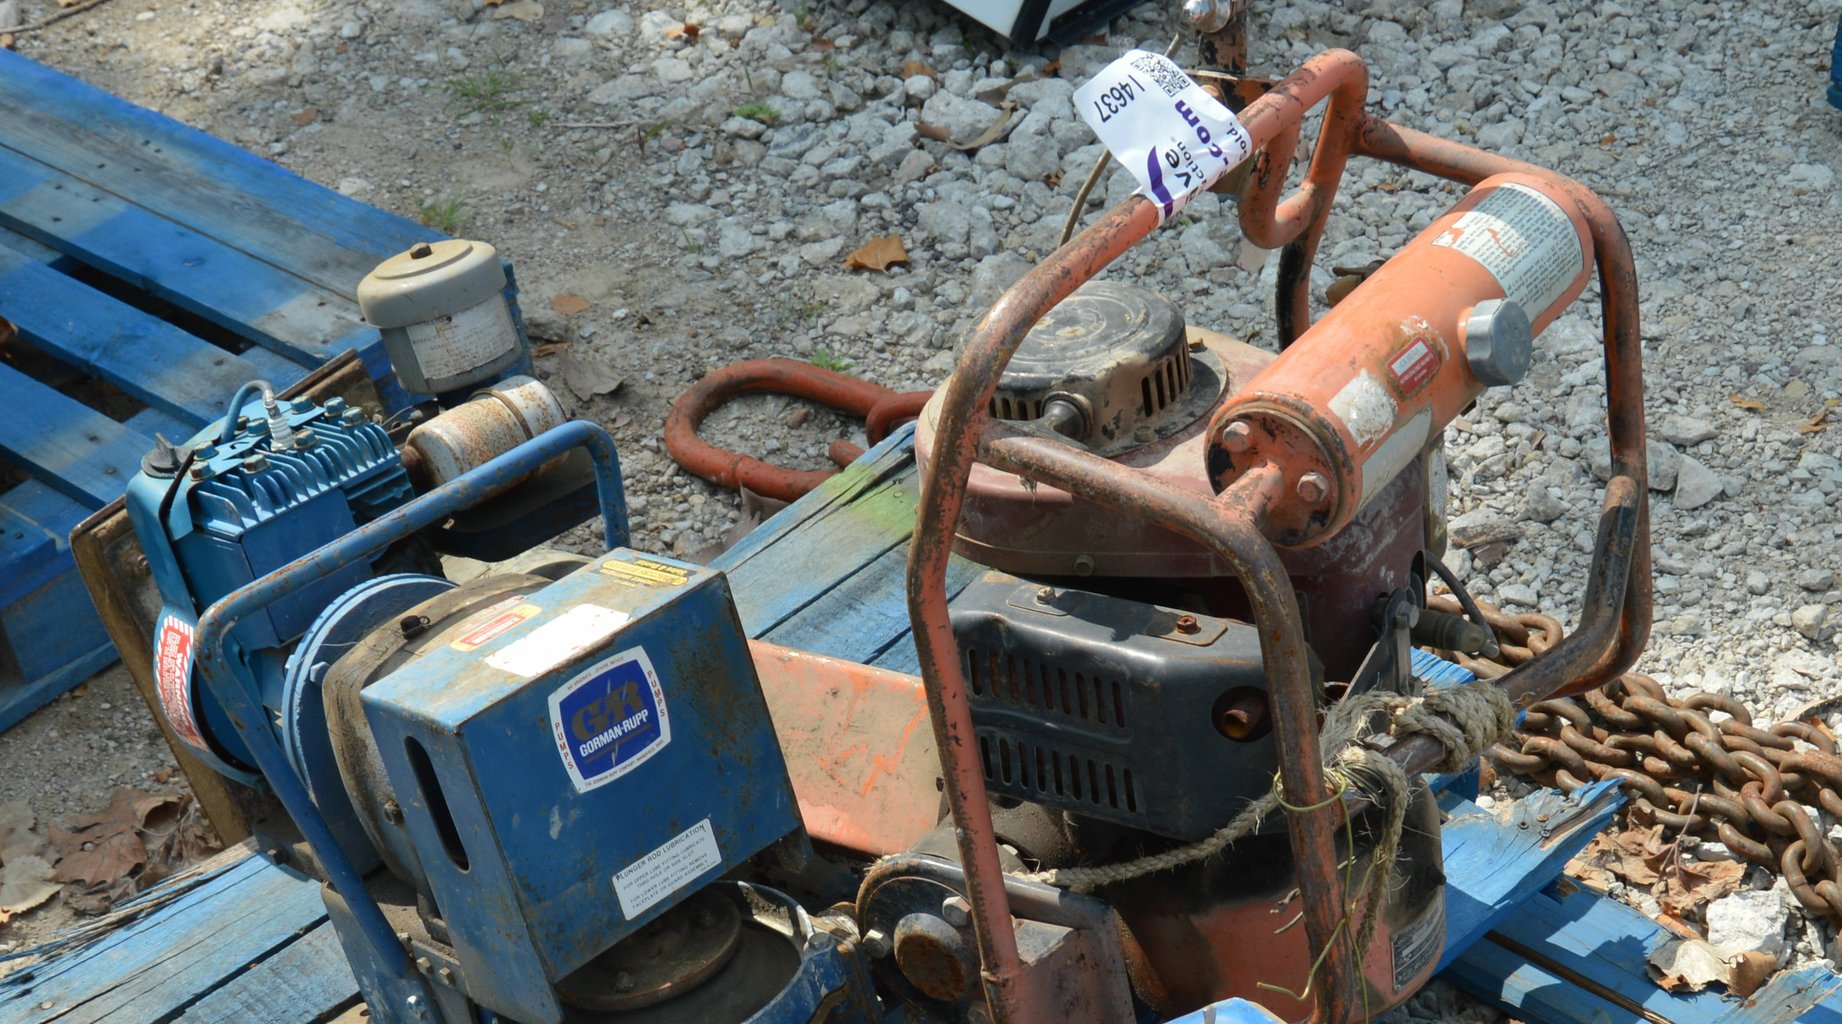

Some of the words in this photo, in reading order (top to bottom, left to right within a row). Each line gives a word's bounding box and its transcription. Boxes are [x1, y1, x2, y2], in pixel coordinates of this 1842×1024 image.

[647, 670, 666, 717] PUMPS
[554, 722, 573, 770] PUMPS
[579, 709, 649, 757] GORMAN-RUPP
[615, 860, 646, 881] PLUNGER
[647, 850, 662, 863] ROD
[662, 824, 706, 853] LUBRICATION
